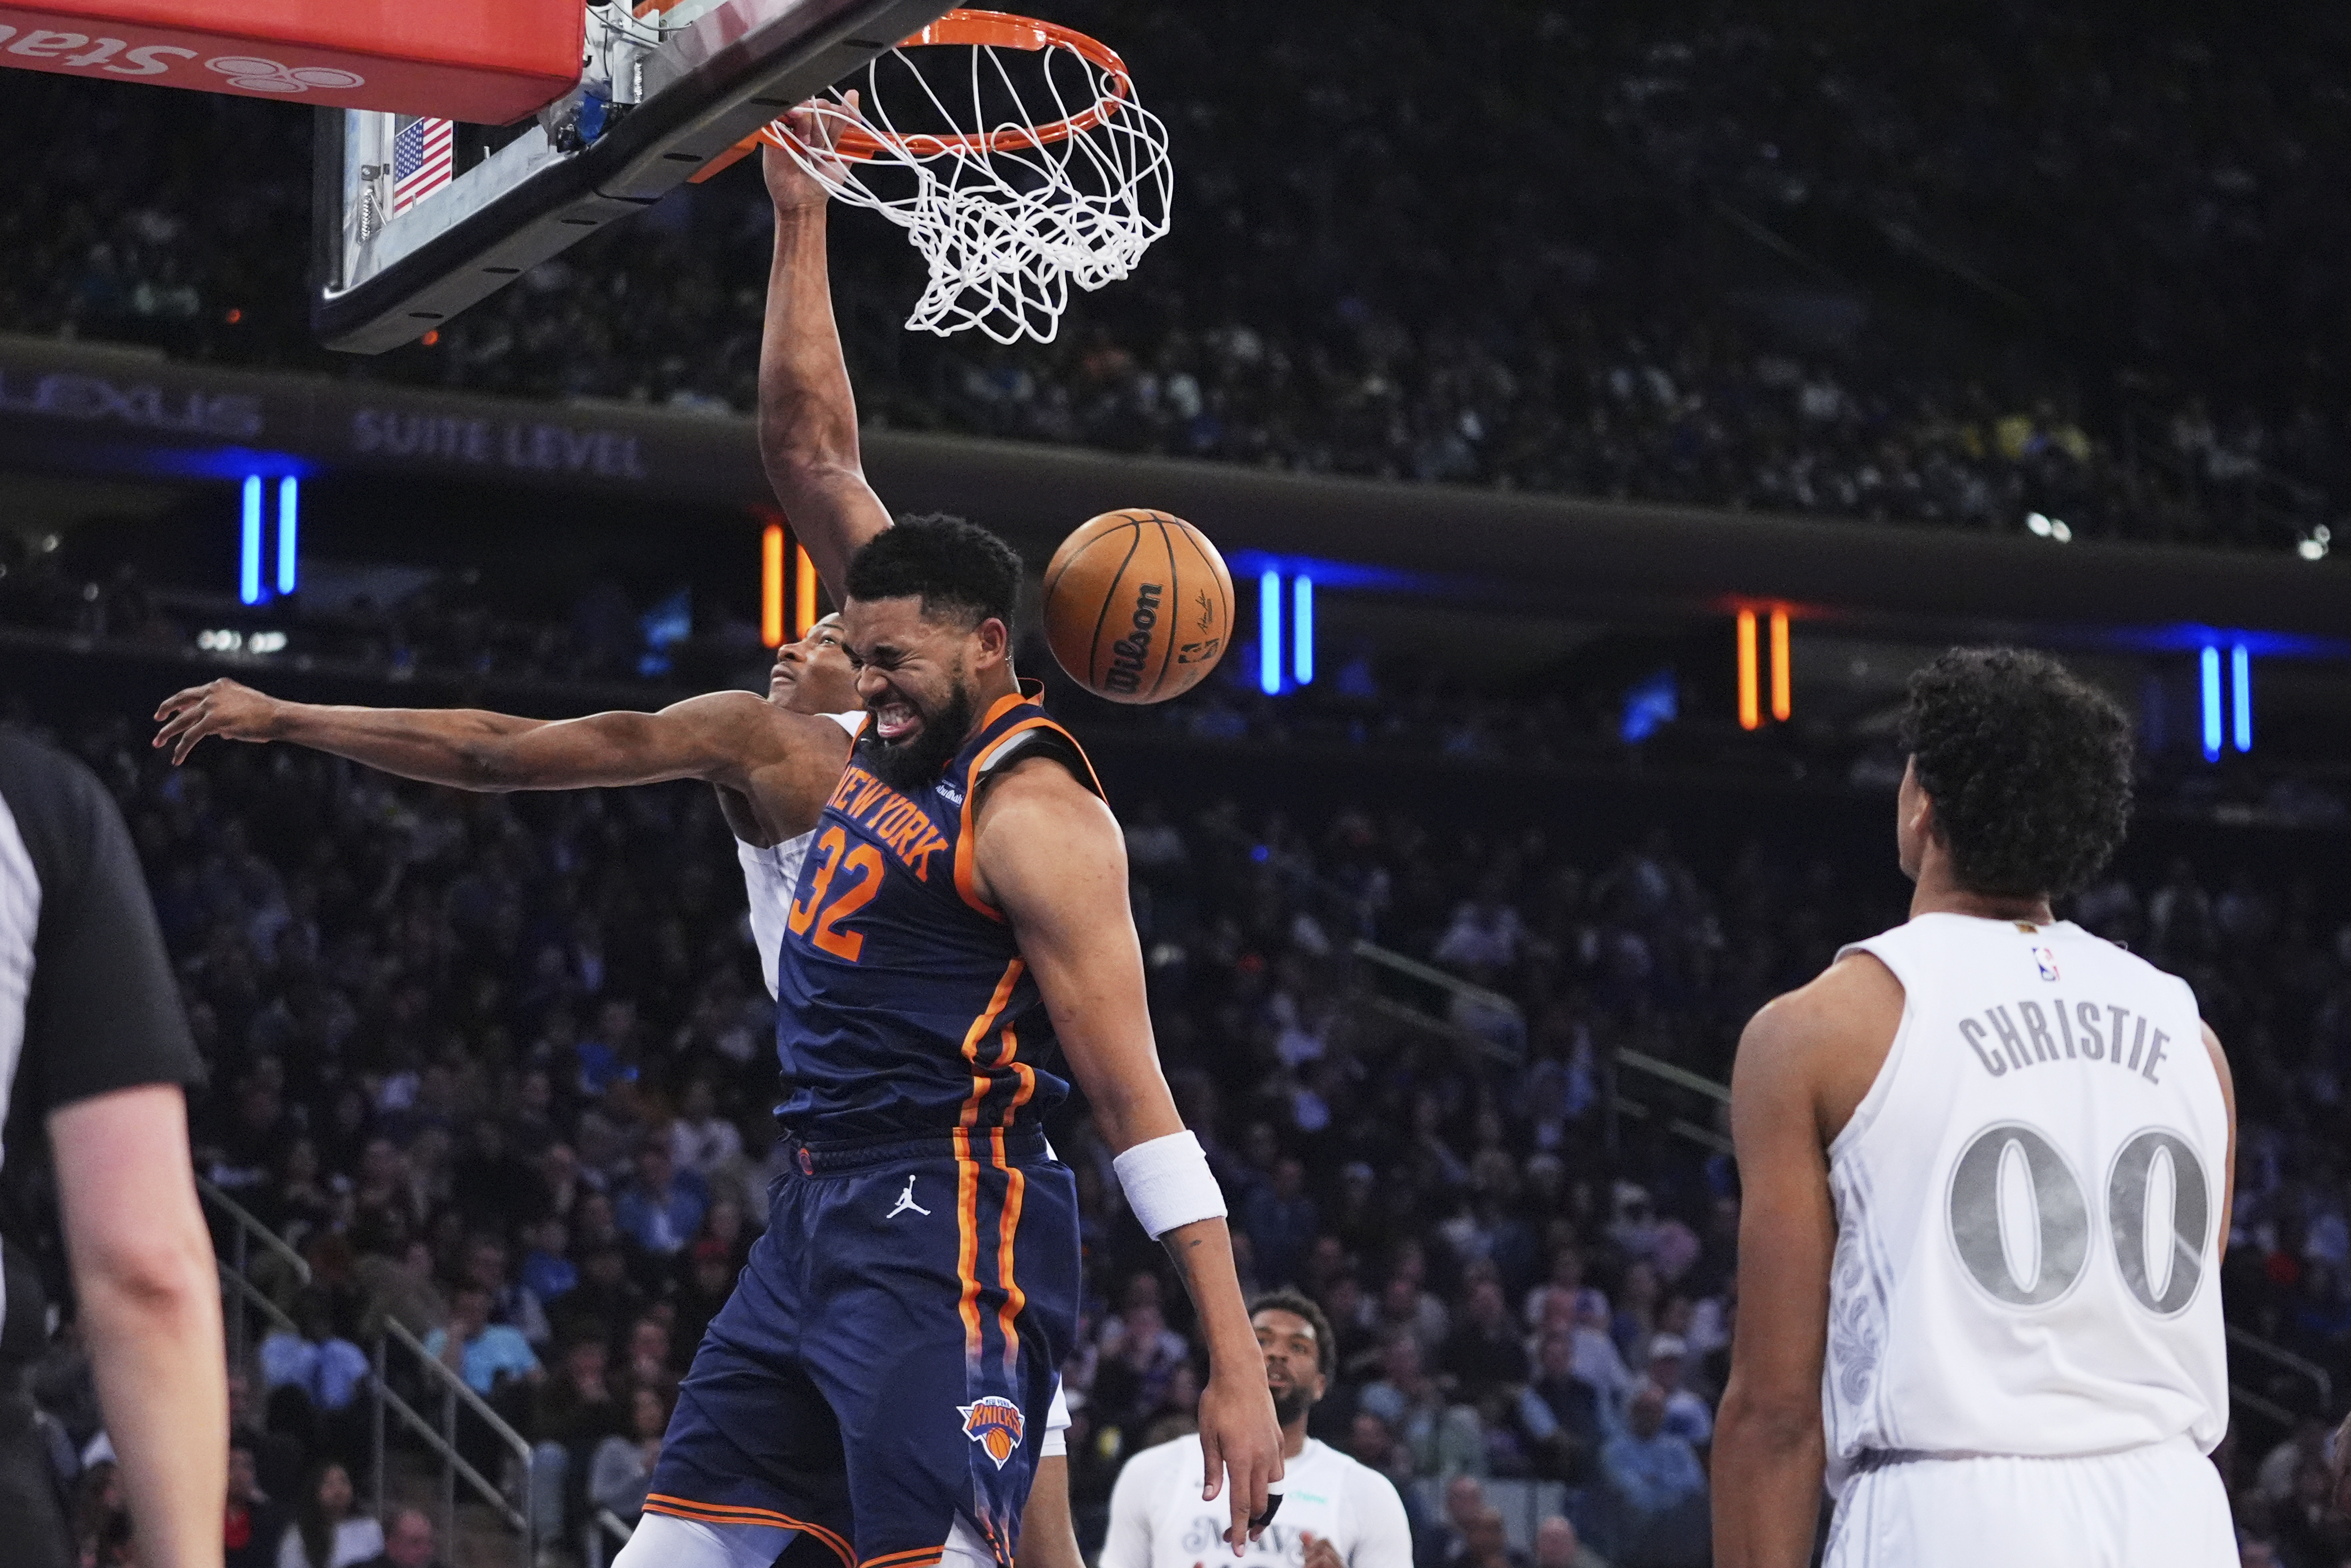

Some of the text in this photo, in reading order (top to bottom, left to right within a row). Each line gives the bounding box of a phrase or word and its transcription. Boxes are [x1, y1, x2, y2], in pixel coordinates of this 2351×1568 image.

[0, 24, 198, 75] Sta
[353, 407, 648, 479] SUITE LEVEL
[1104, 583, 1162, 694] Wilson
[826, 765, 949, 883] NEW YORK
[788, 825, 885, 963] 32
[1959, 999, 2171, 1085] CHRISTIE
[1945, 1119, 2212, 1321] 00
[967, 1403, 1021, 1438] KNICKS
